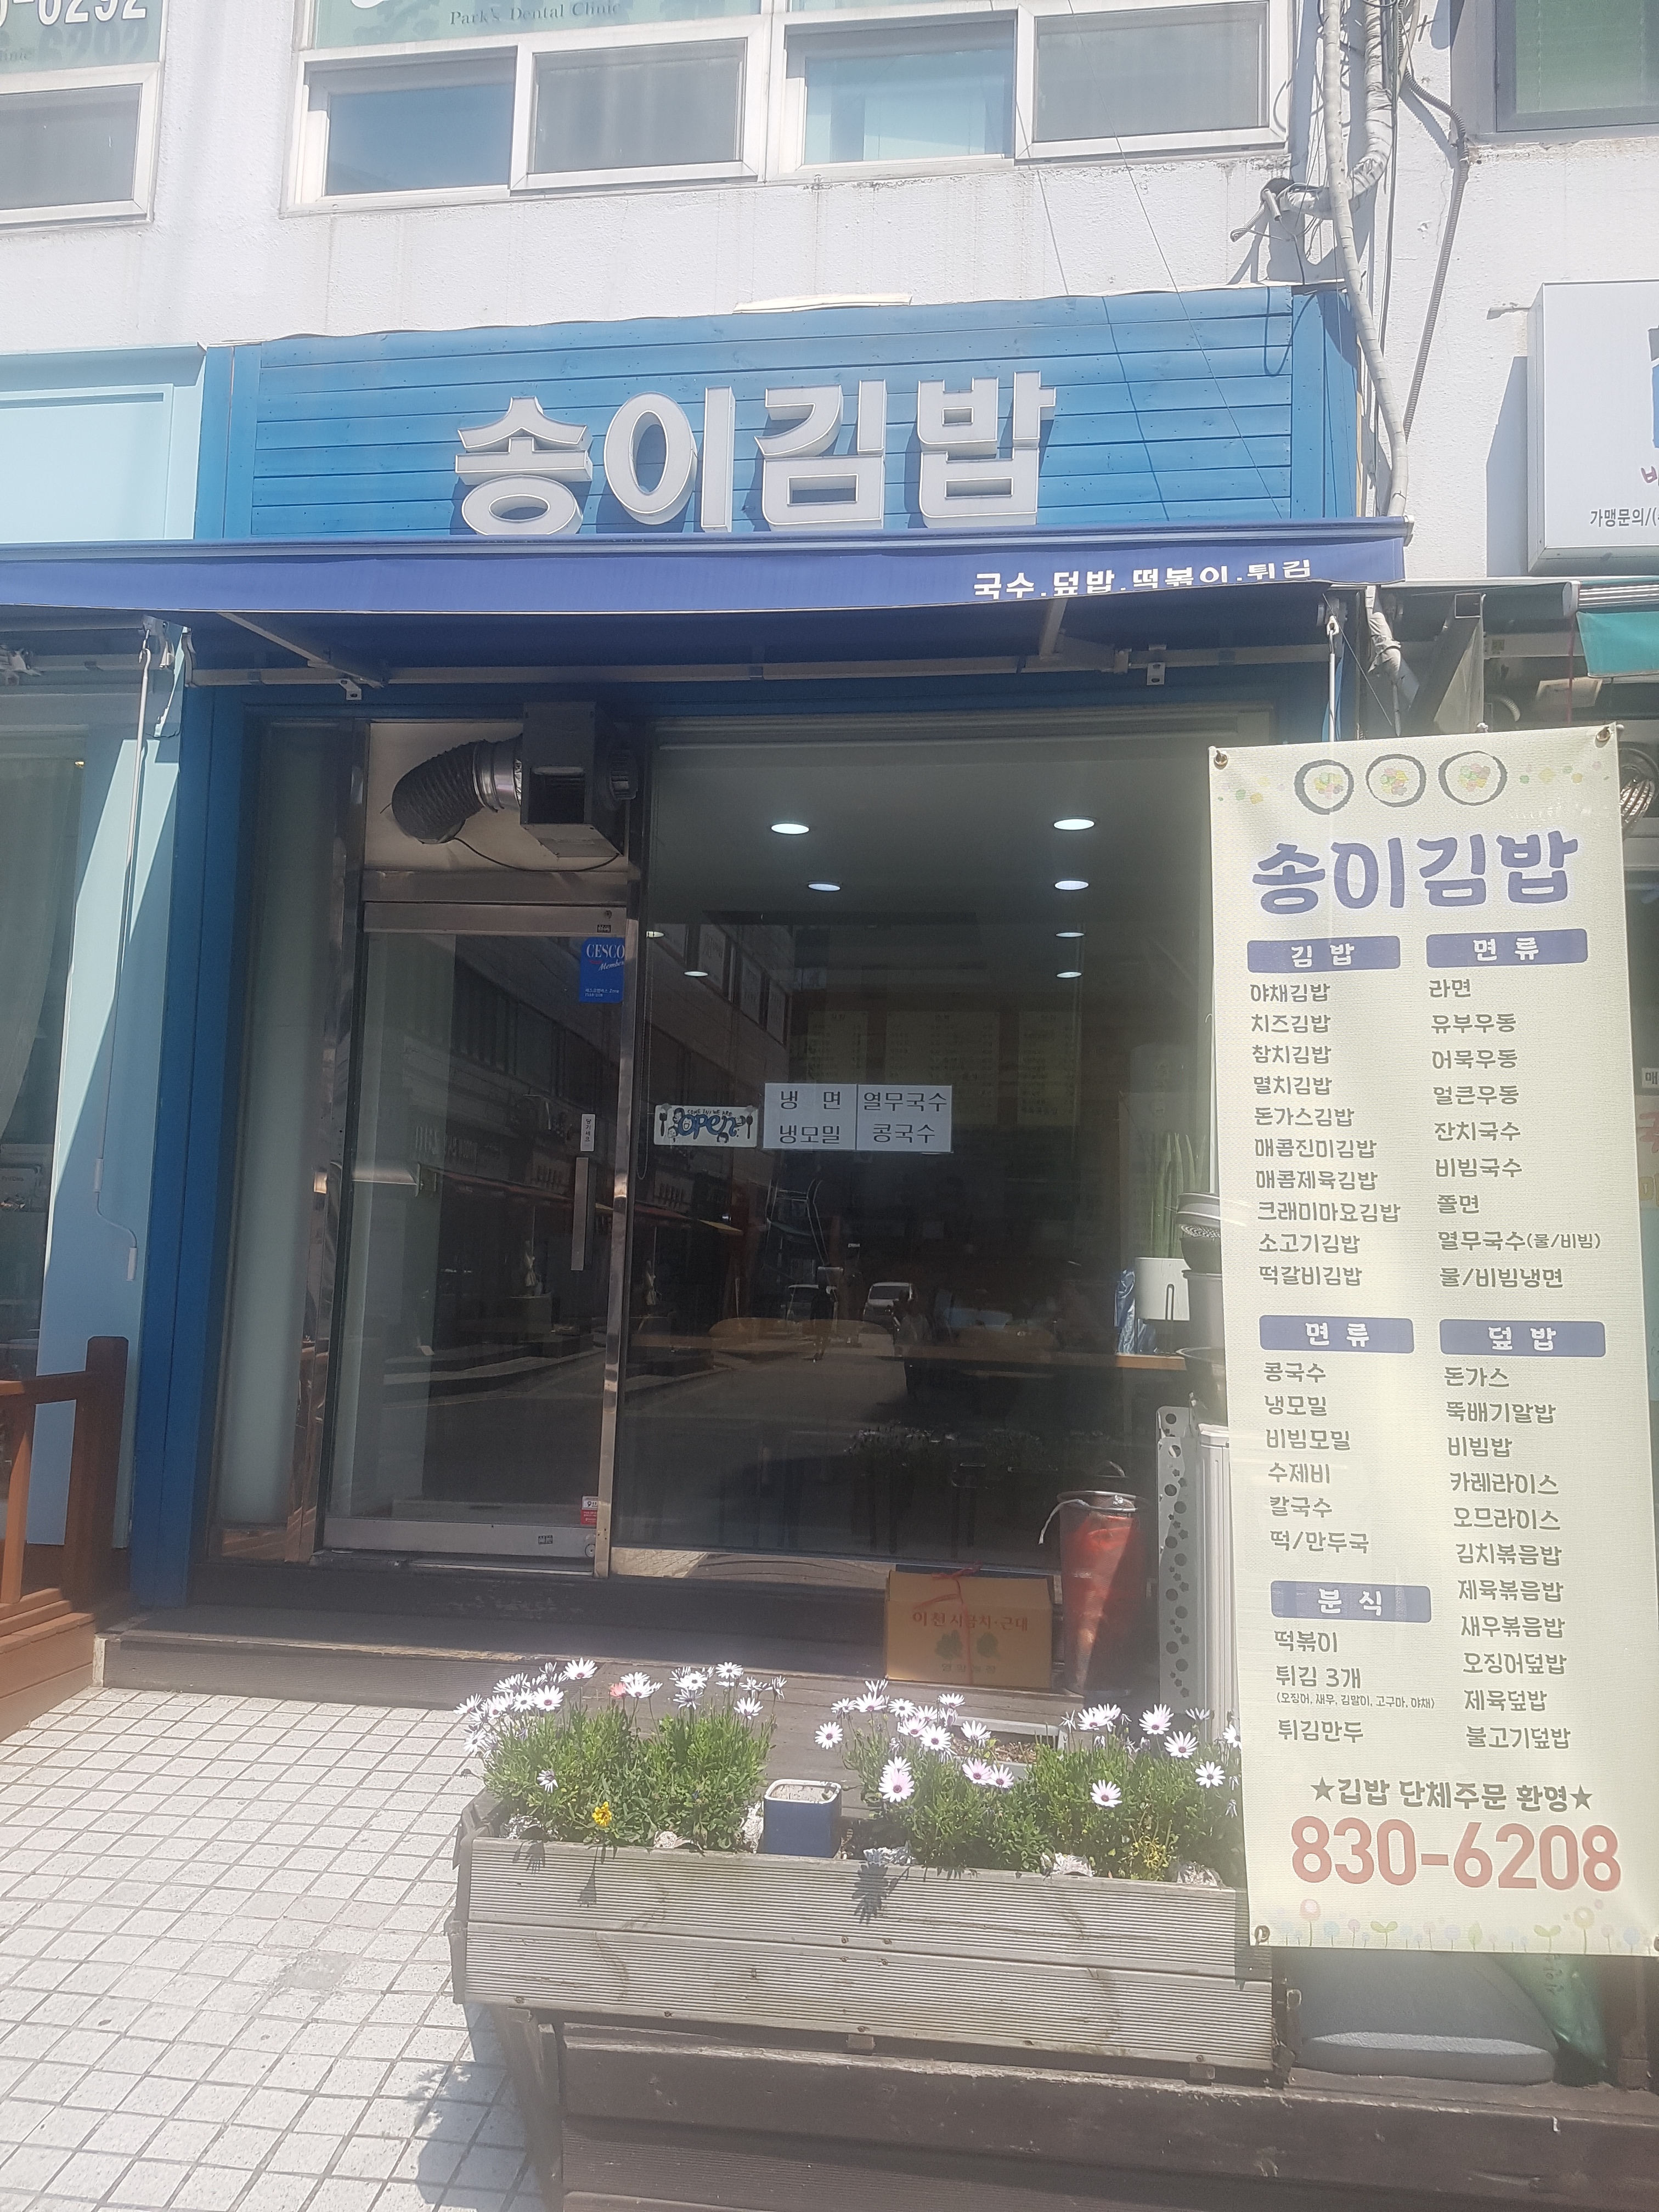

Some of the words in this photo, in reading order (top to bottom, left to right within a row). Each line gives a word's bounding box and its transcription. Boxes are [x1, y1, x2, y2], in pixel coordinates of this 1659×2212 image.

[450, 9, 503, 25] Park's
[510, 4, 565, 21] Dental
[571, 1, 622, 18] Clinic
[453, 370, 1058, 534] 송이김밥
[1252, 829, 1578, 916] 송이김밥
[586, 943, 625, 958] CESCO
[1250, 983, 1330, 1002] 야채김밥
[1429, 978, 1471, 998] 라면
[1251, 1013, 1331, 1033] 치즈김밥
[1431, 1013, 1516, 1034] 유부우동
[1252, 1045, 1331, 1064] 참치김밥
[1432, 1049, 1518, 1069] 어묵우동
[1253, 1075, 1333, 1095] 멸치김밥
[1433, 1085, 1519, 1105] 얼큰우동
[863, 1091, 948, 1113] 열무국수
[1254, 1107, 1355, 1127] 돈가스김밥
[778, 1124, 841, 1145] 냉모밀
[871, 1122, 936, 1144] 콩국수
[1434, 1121, 1521, 1142] 잔치국수
[1255, 1138, 1378, 1159] 매콤진미김밥
[1435, 1158, 1522, 1178] 비빔국수
[1255, 1170, 1378, 1191] 매콤제육김밥
[1257, 1201, 1401, 1223] 크래미마요김밥
[1437, 1194, 1480, 1214] 쫄면
[1259, 1233, 1360, 1254] 소고기김밥
[1259, 1265, 1362, 1286] 떡갈비김밥
[1439, 1267, 1564, 1288] 물/비빔냉면
[1263, 1362, 1326, 1383] 콩국수
[1444, 1367, 1510, 1387] 돈가스
[1264, 1395, 1327, 1417] 냉모밀
[1446, 1401, 1556, 1424] 뚝배기알밥
[1266, 1429, 1351, 1451] 비빔모밀
[1447, 1436, 1513, 1458] 비빔밥
[1268, 1462, 1330, 1484] 수제비
[1450, 1471, 1559, 1495] 카레라이스
[1269, 1496, 1333, 1518] 칼국수
[1454, 1507, 1560, 1531] 오므라이스
[1269, 1530, 1369, 1554] 떡/만두국
[1455, 1543, 1562, 1566] 김치볶음밥
[1457, 1579, 1564, 1602] 제육볶음밥
[1460, 1616, 1565, 1639] 새우볶음밥
[1274, 1630, 1338, 1652] 떡볶이
[1463, 1652, 1567, 1675] 오징어덮밥
[1276, 1665, 1317, 1687] 튀김
[1325, 1667, 1361, 1689] 3개
[1464, 1689, 1548, 1712] 제육덮밥
[1278, 1719, 1364, 1743] 튀김만두
[1466, 1725, 1571, 1749] 불고기덮밥
[1399, 1779, 1507, 1810] 단체주문
[1291, 1815, 1622, 1892] 830-6208
